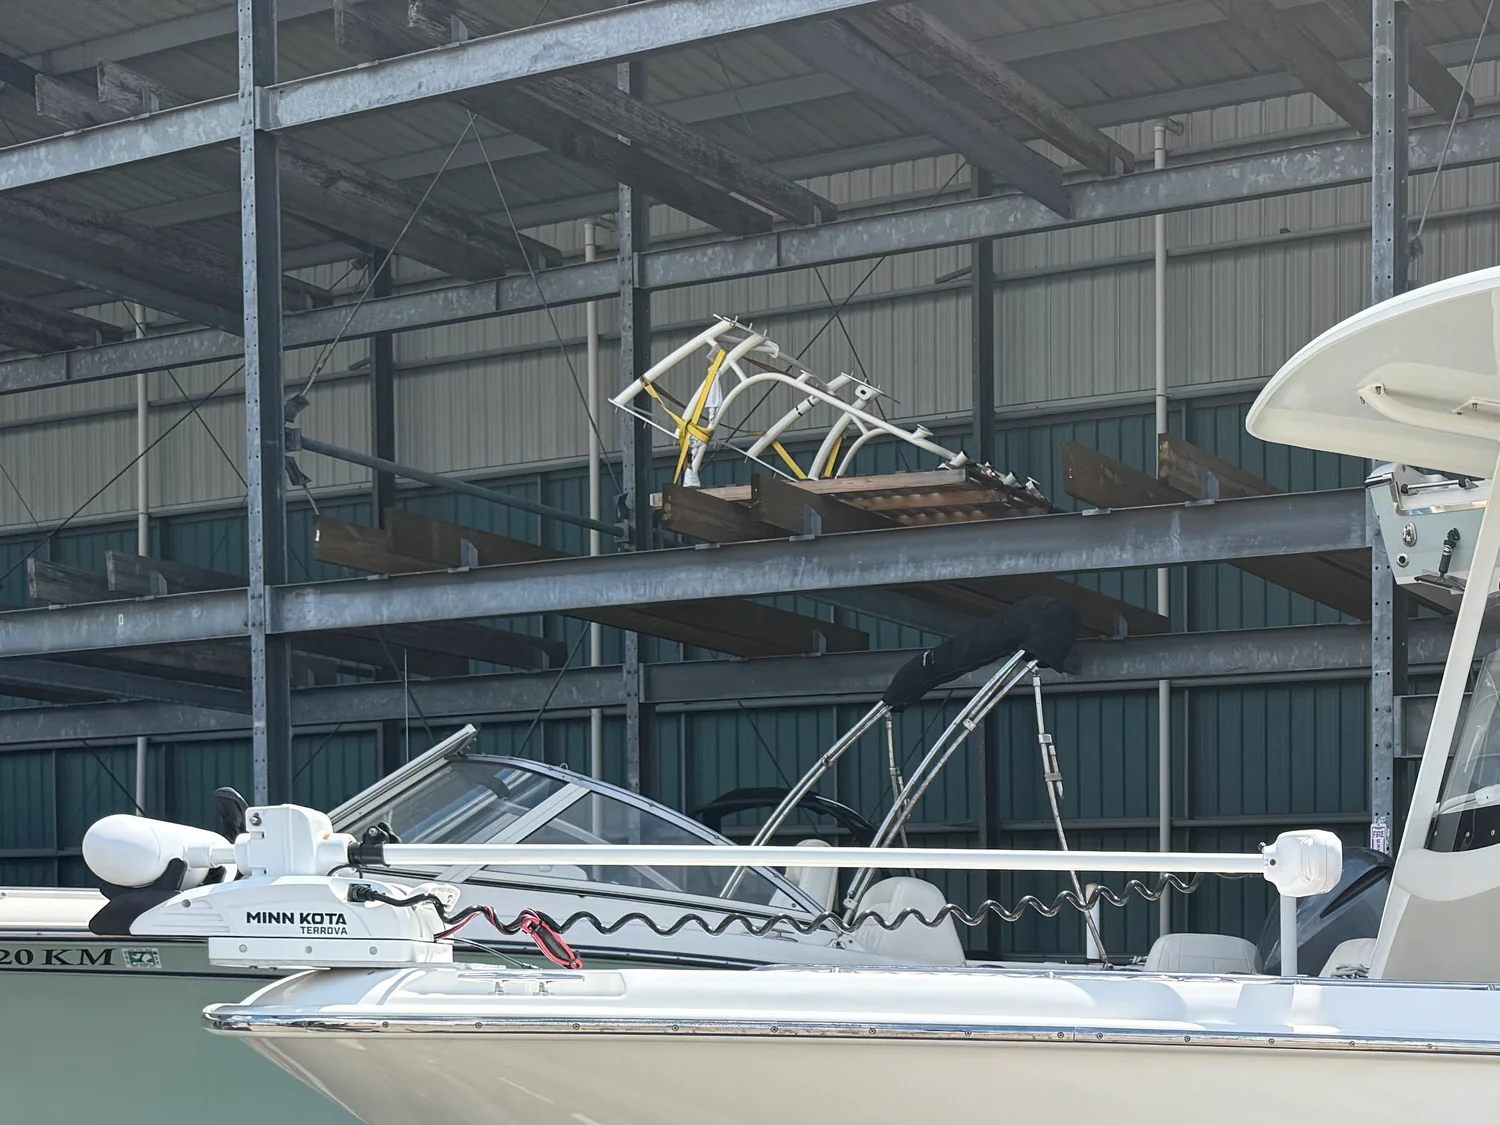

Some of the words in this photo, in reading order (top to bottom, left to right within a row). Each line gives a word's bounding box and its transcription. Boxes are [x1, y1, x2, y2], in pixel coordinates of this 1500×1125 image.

[246, 911, 295, 924] MINN
[299, 912, 347, 925] KOTA
[300, 926, 348, 935] TERROVA
[41, 947, 117, 966] KM
